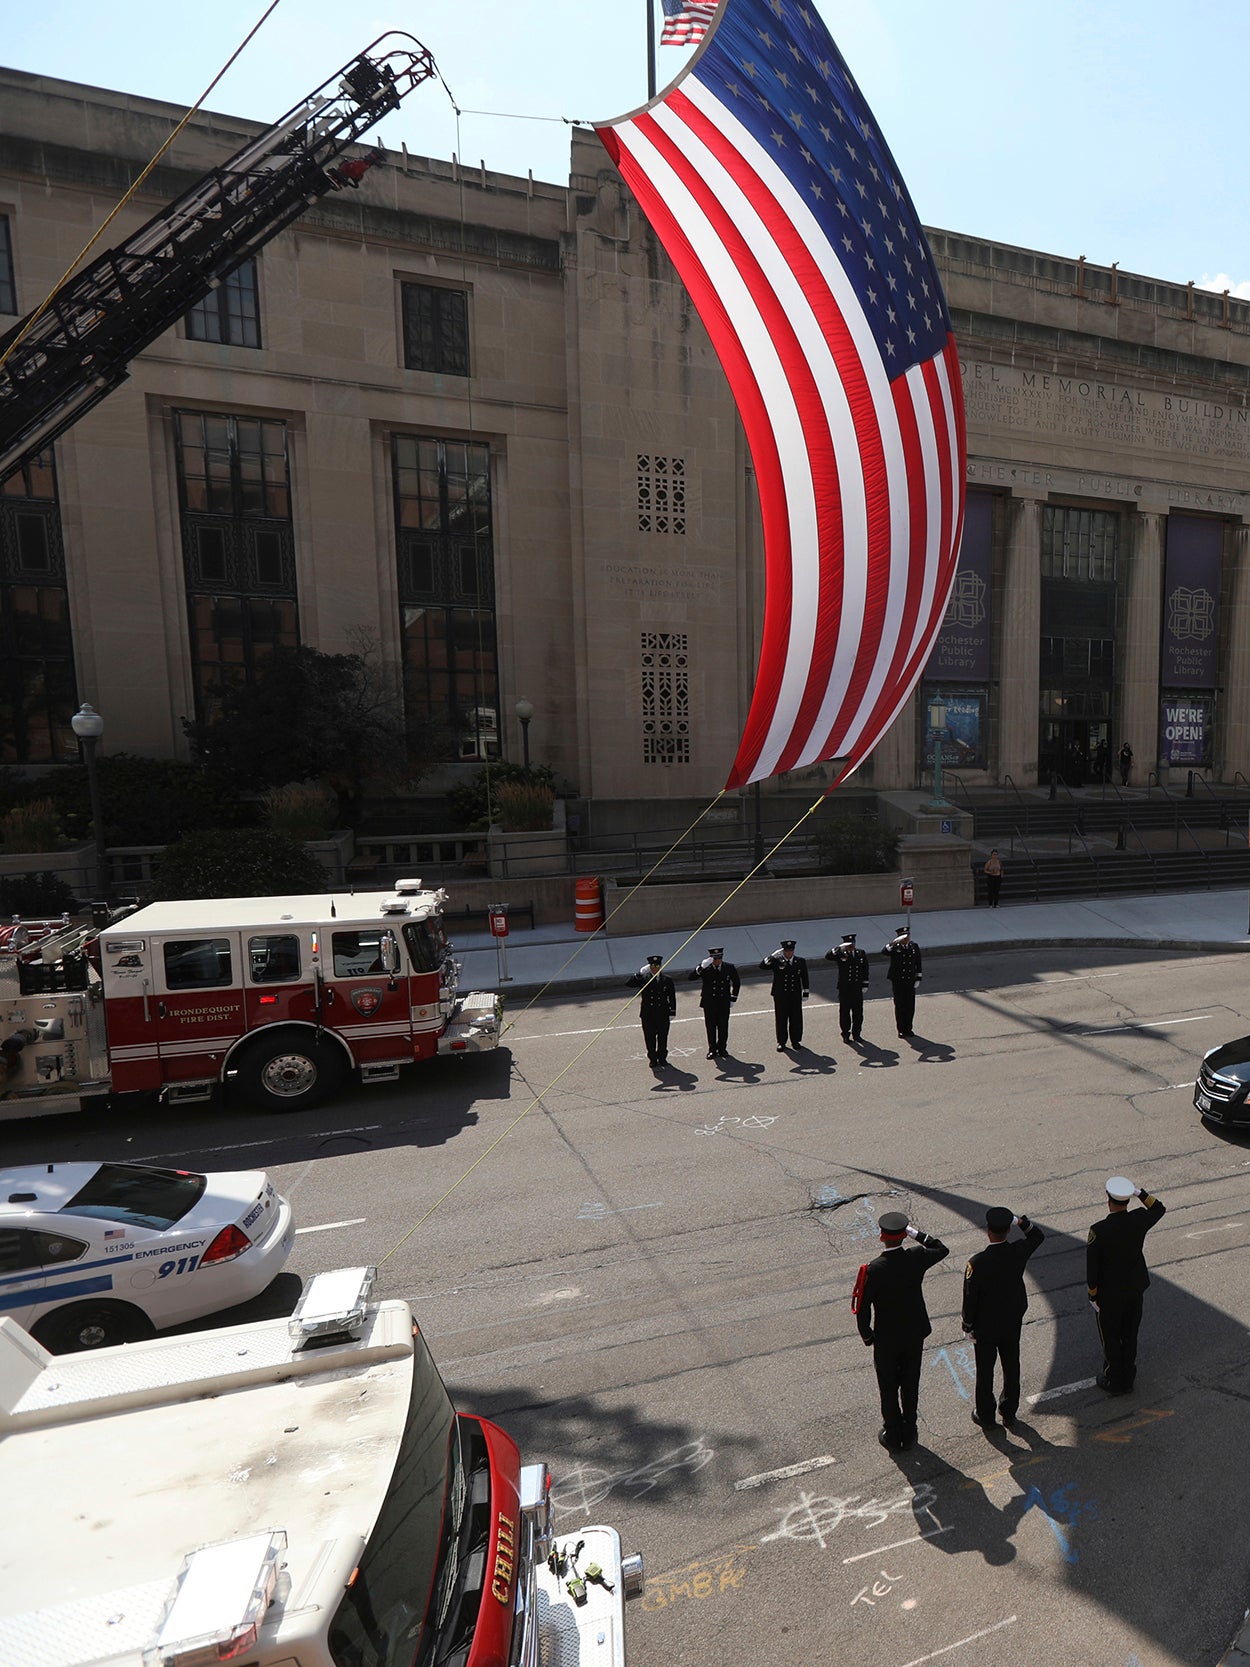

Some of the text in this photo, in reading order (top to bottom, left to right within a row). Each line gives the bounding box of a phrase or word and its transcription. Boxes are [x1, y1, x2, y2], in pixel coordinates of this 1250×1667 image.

[960, 362, 1000, 381] DEL
[1022, 372, 1145, 406] MEMORIAL
[1023, 399, 1042, 409] THE
[1045, 402, 1068, 413] FINE
[1070, 406, 1104, 418] THINGS
[1108, 412, 1121, 421] OF
[1124, 415, 1141, 424] LIFE
[1144, 418, 1166, 428] THAT
[1168, 422, 1180, 430] HE
[1183, 425, 1202, 434] WAS
[1206, 428, 1243, 441] INSPIRED
[1058, 394, 1078, 404] FOR
[1082, 398, 1100, 408] THE
[1105, 402, 1124, 412] USE
[1127, 406, 1148, 416] AND
[1152, 410, 1206, 426] ENJOYMENT
[1209, 419, 1221, 428] OF
[1224, 422, 1239, 431] ALL
[964, 398, 1002, 412] EQUEST
[1006, 405, 1020, 414] TO
[1024, 408, 1042, 418] THE
[1046, 412, 1067, 422] CITY
[1070, 416, 1082, 424] OF
[1087, 418, 1141, 433] ROCHESTER
[1145, 428, 1177, 439] WHERE
[1182, 433, 1193, 442] HE
[1196, 436, 1220, 446] LONG
[1223, 440, 1247, 450] MADE
[1035, 420, 1056, 430] AND
[1061, 424, 1100, 437] BEAUTY
[1153, 438, 1169, 447] THE
[967, 463, 1237, 510] CHESTER PUBLIC LIBRARY
[937, 635, 985, 646] ochester
[941, 645, 974, 656] Public
[1168, 645, 1212, 657] Rochester
[938, 656, 976, 669] Library
[1176, 656, 1202, 666] Public
[1174, 665, 1204, 678] Library
[1166, 708, 1203, 723] WE'RE
[1165, 726, 1203, 740] OPEN!
[169, 1005, 241, 1017] IRONDEQUOIT
[180, 1014, 232, 1024] FIRE DIST.
[135, 1239, 206, 1260] EMERGENCY
[157, 1255, 199, 1280] 911
[491, 1511, 515, 1603] CHILI
[850, 1570, 903, 1606] TEL
